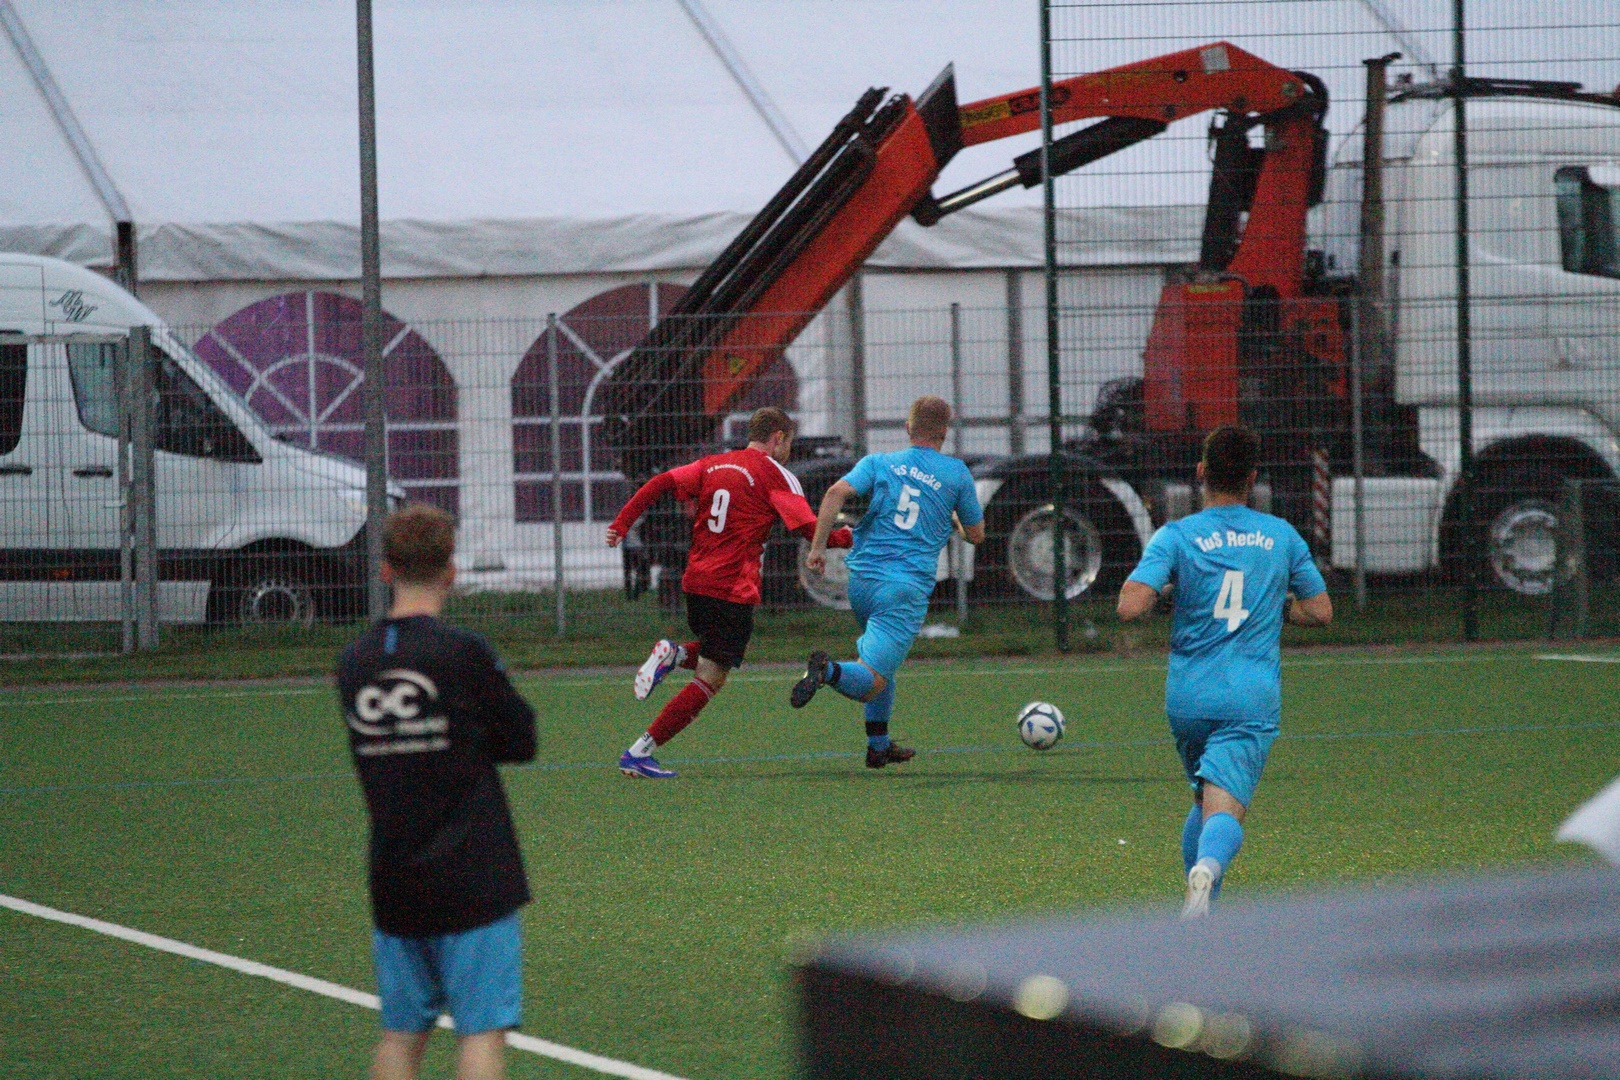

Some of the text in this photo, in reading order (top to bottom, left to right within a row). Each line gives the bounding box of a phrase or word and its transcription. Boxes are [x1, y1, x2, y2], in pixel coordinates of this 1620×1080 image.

[909, 466, 942, 491] Recke
[708, 489, 730, 533] 9
[894, 484, 921, 530] 5
[1195, 530, 1274, 552] TuS Recke
[1213, 570, 1249, 632] 4
